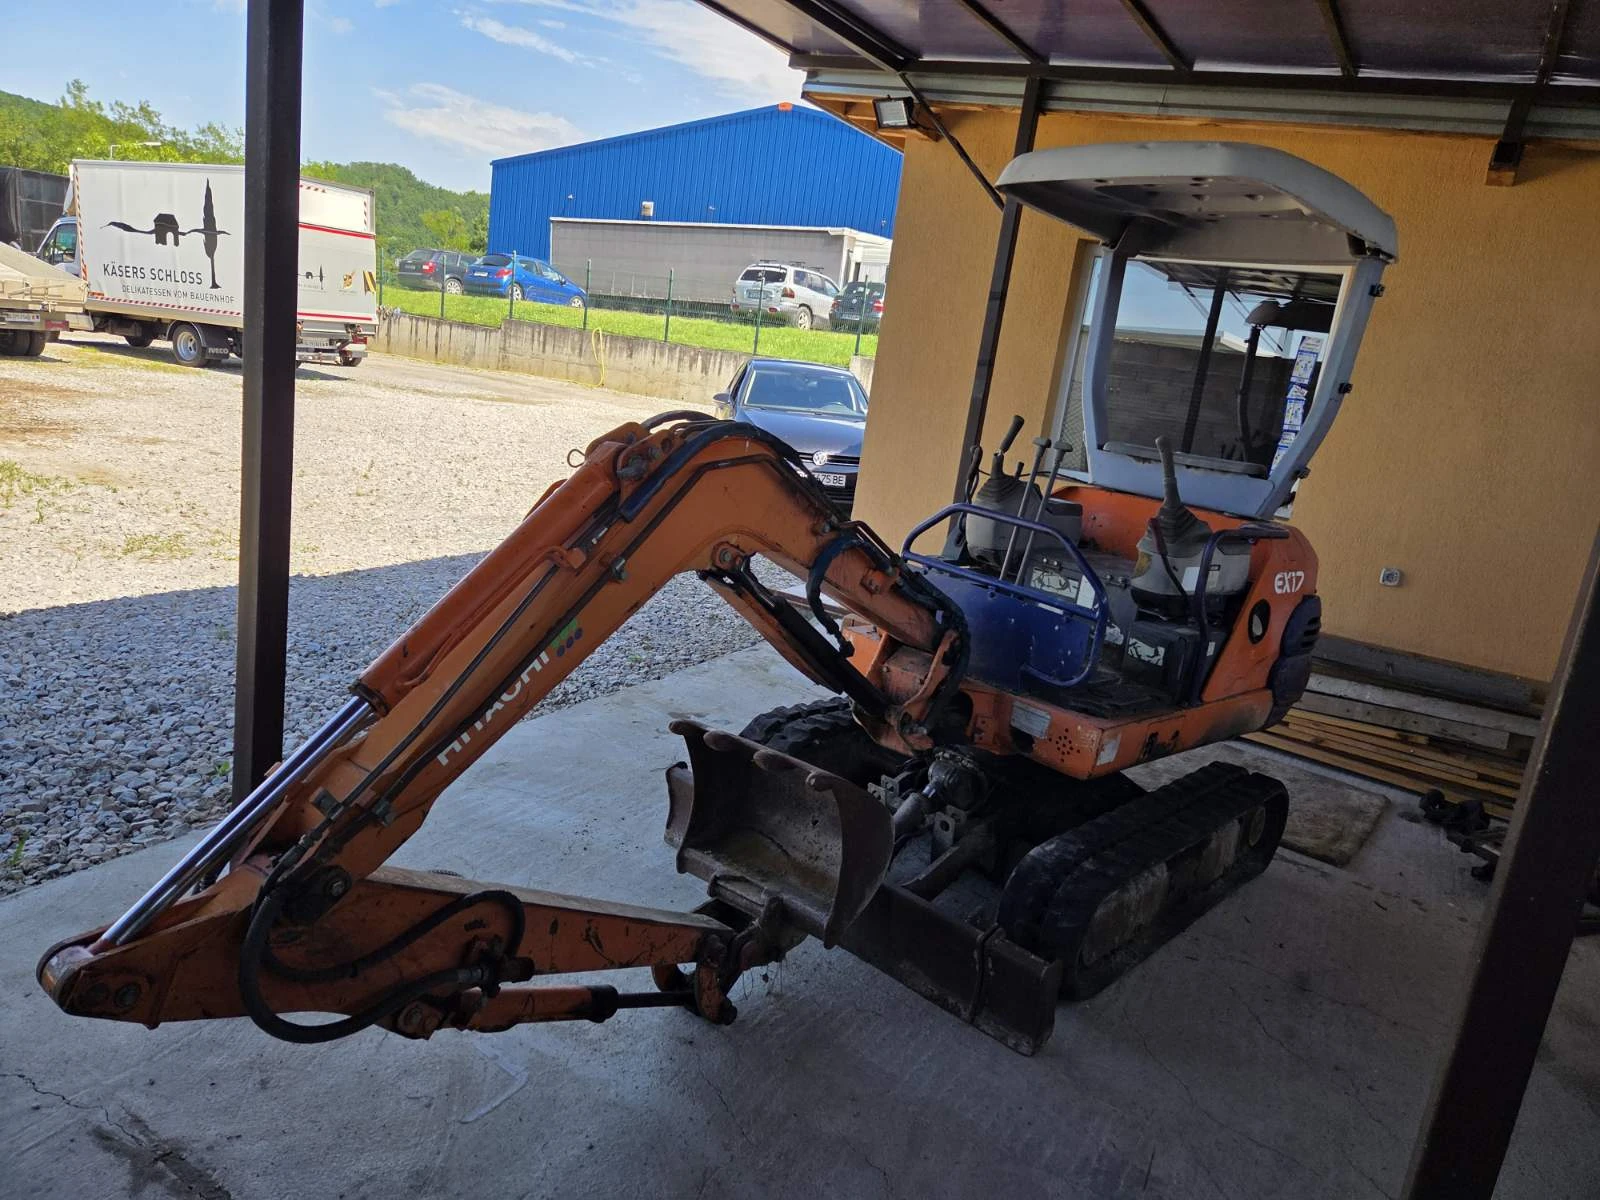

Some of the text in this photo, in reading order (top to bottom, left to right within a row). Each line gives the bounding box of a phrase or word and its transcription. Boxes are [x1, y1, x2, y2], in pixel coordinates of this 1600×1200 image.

[103, 261, 203, 285] KÄSERS SCHLOSS
[122, 284, 235, 304] DELIKATESSEN VOM BAUERNHOF
[1274, 571, 1305, 594] EX17
